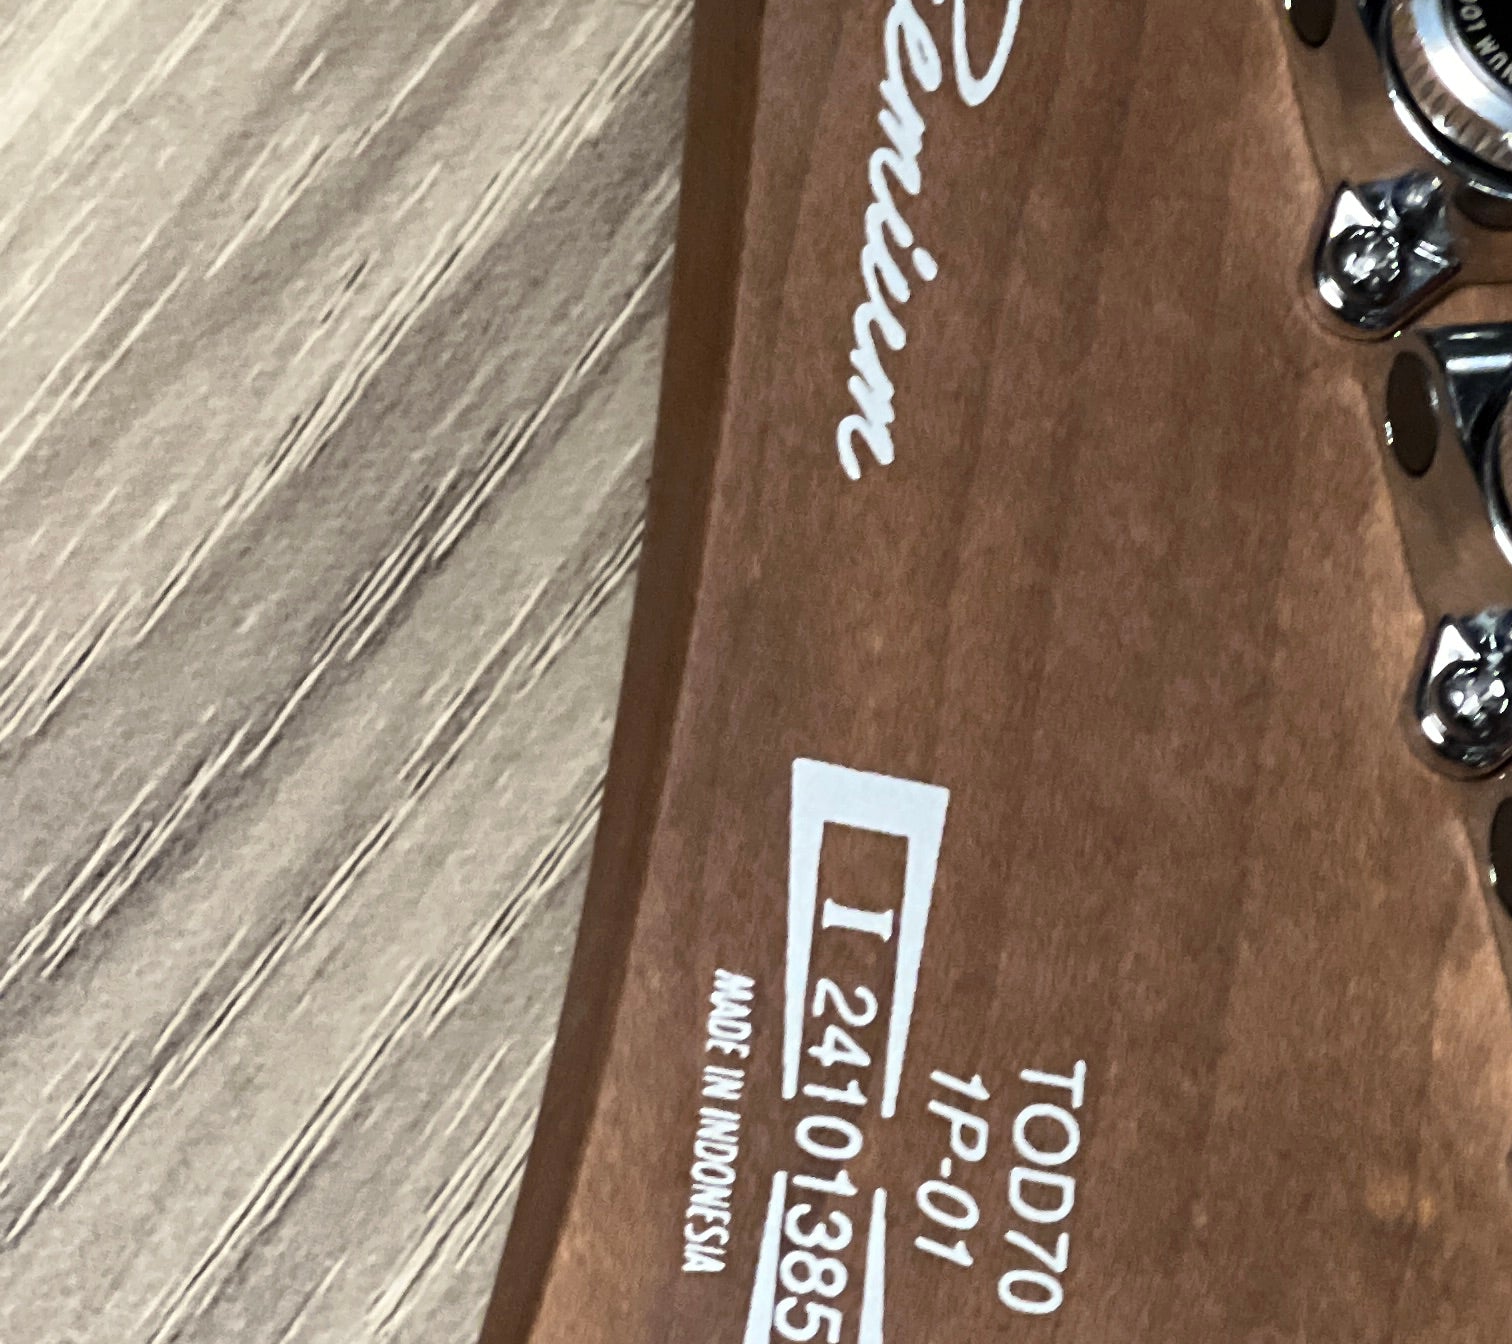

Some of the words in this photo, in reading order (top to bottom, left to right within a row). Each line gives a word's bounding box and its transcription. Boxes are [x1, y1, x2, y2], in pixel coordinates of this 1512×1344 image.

[700, 1063, 746, 1101] IN
[704, 969, 755, 1060] MADE
[682, 1106, 744, 1273] INDONESIA
[914, 1069, 990, 1267] 1P-01
[997, 1060, 1087, 1316] TOD70
